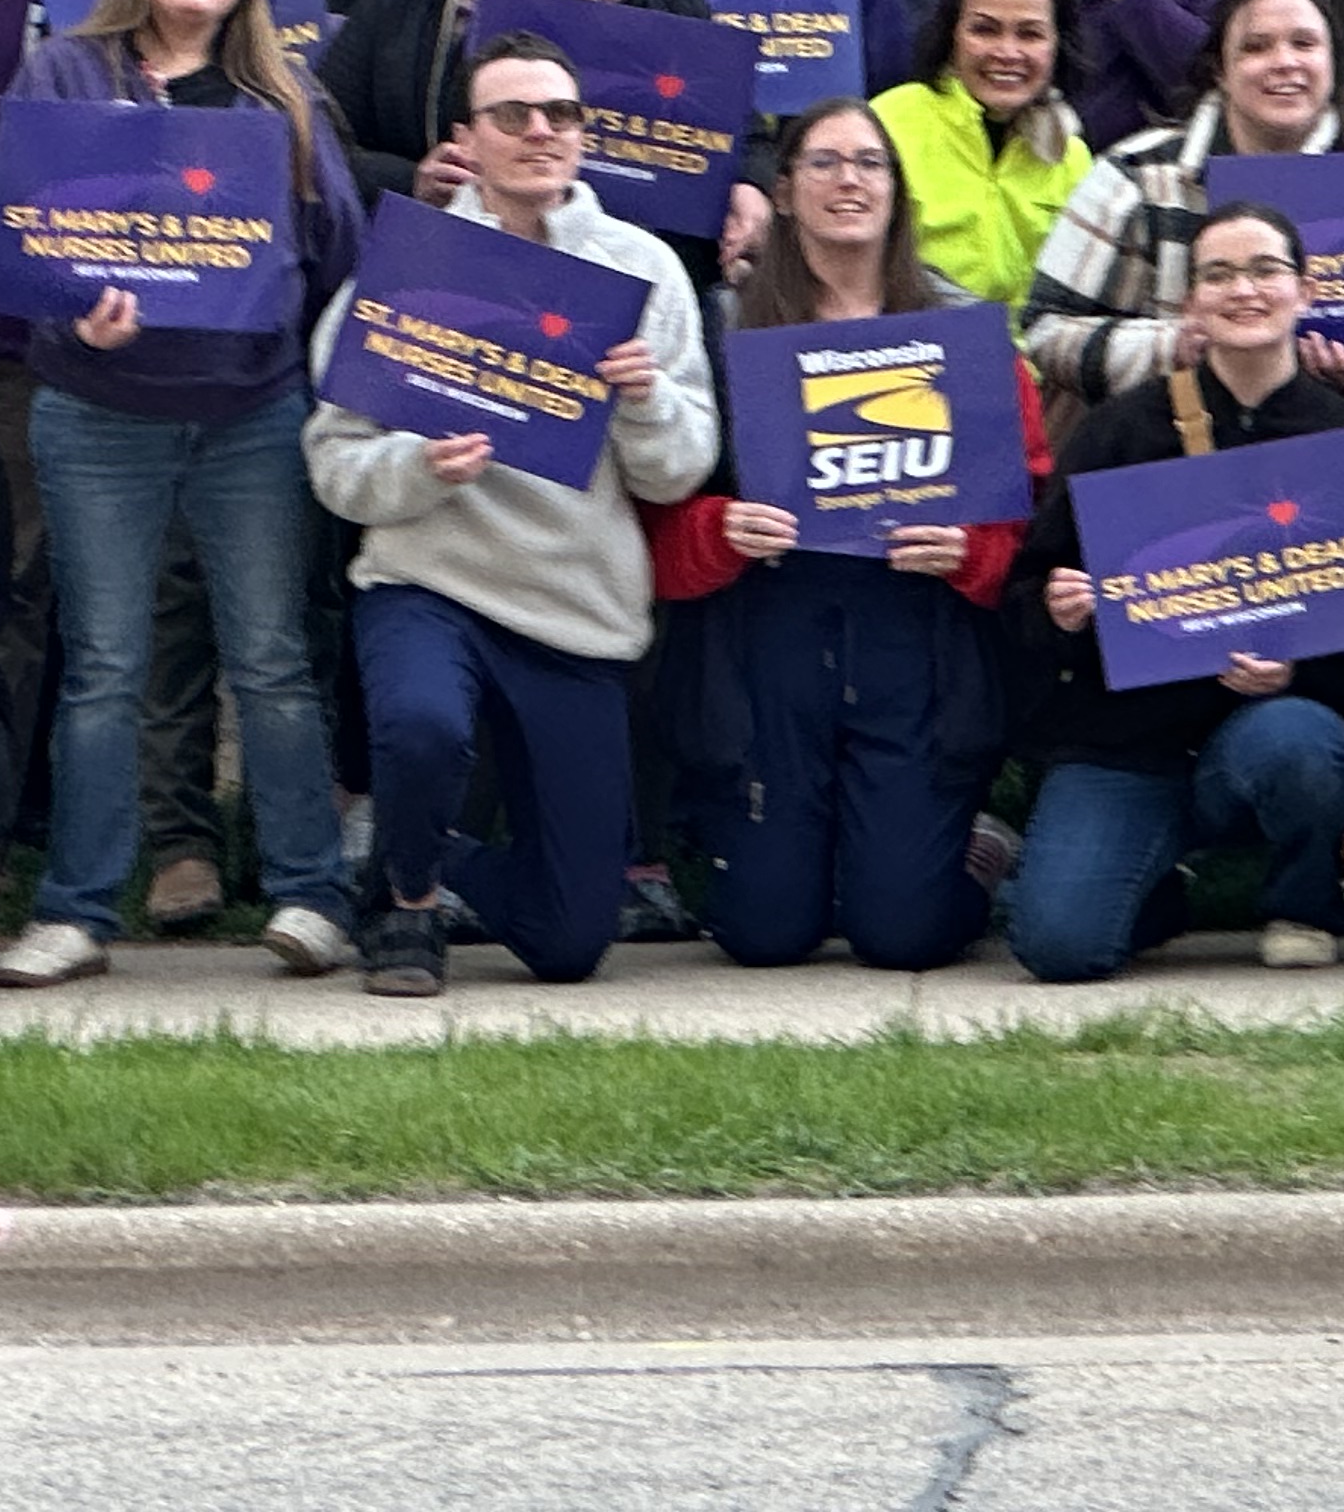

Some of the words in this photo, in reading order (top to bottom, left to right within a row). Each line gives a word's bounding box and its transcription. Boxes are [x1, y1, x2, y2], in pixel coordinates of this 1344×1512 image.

[771, 12, 850, 34] DEAN
[650, 119, 735, 154] DEAN
[49, 208, 159, 236] MARY'S
[159, 215, 184, 238] &
[186, 216, 273, 243] DEAN
[22, 234, 139, 264] NURSES
[140, 240, 252, 269] UNITED
[796, 339, 946, 375] Wisconsin
[363, 331, 478, 386] NURSES
[477, 369, 584, 421] UNITED
[505, 351, 527, 375] &
[529, 358, 607, 402] DEAN
[807, 434, 953, 490] SEIU
[1101, 575, 1146, 600] ST.
[1145, 556, 1255, 592] MARY'S
[1257, 551, 1281, 574] &
[1126, 586, 1242, 624] NURSES
